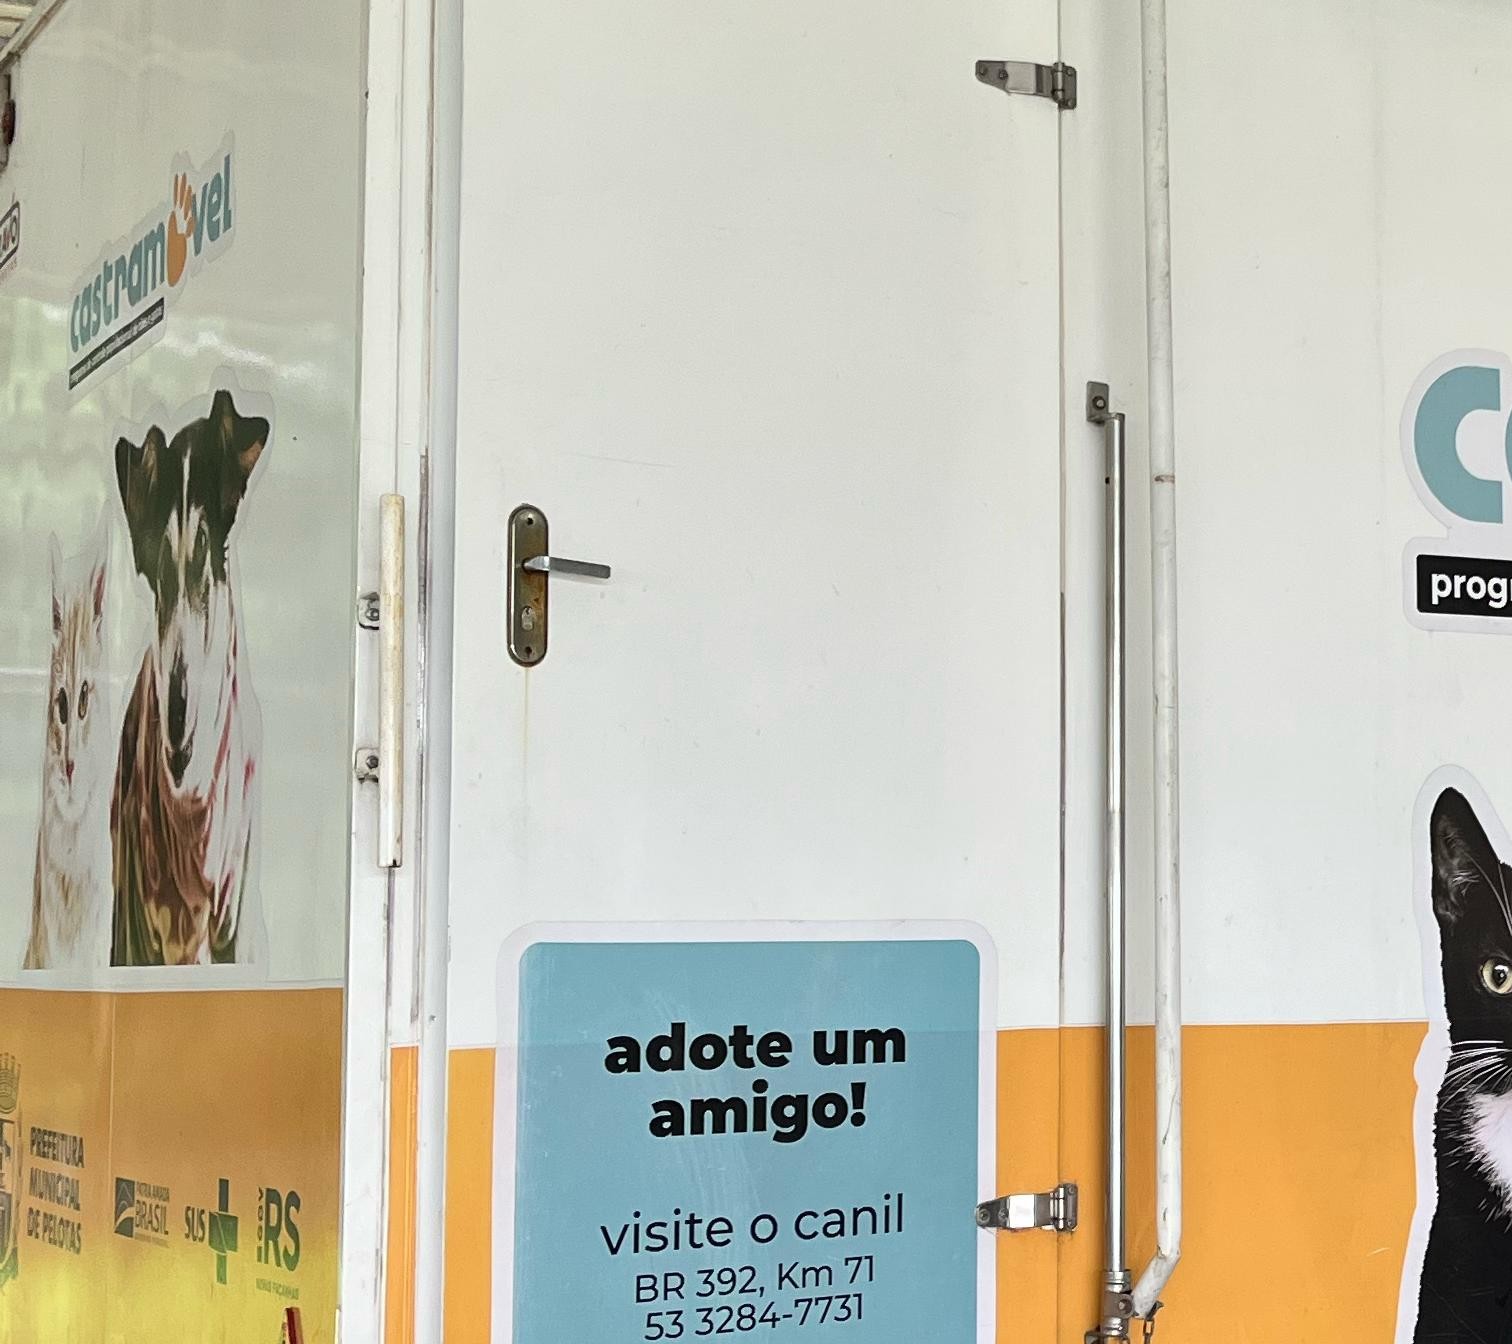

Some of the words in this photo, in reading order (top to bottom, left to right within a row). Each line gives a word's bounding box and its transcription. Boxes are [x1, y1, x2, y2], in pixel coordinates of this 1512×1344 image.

[604, 1022, 794, 1074] adote
[813, 1025, 907, 1066] um
[648, 1078, 867, 1144] amigo!
[30, 1126, 85, 1169] PREFEITURA
[135, 1199, 169, 1236] BRASIL
[184, 1205, 206, 1243] SUS
[264, 1187, 301, 1272] RS
[600, 1208, 734, 1256] visite
[750, 1213, 778, 1245] o
[794, 1193, 905, 1241] canil
[635, 1271, 686, 1304] BR
[695, 1264, 766, 1299] 392,
[777, 1260, 833, 1292] Km
[844, 1255, 875, 1284] 71
[644, 1309, 685, 1341] 53
[694, 1293, 865, 1337] 3284-7731
